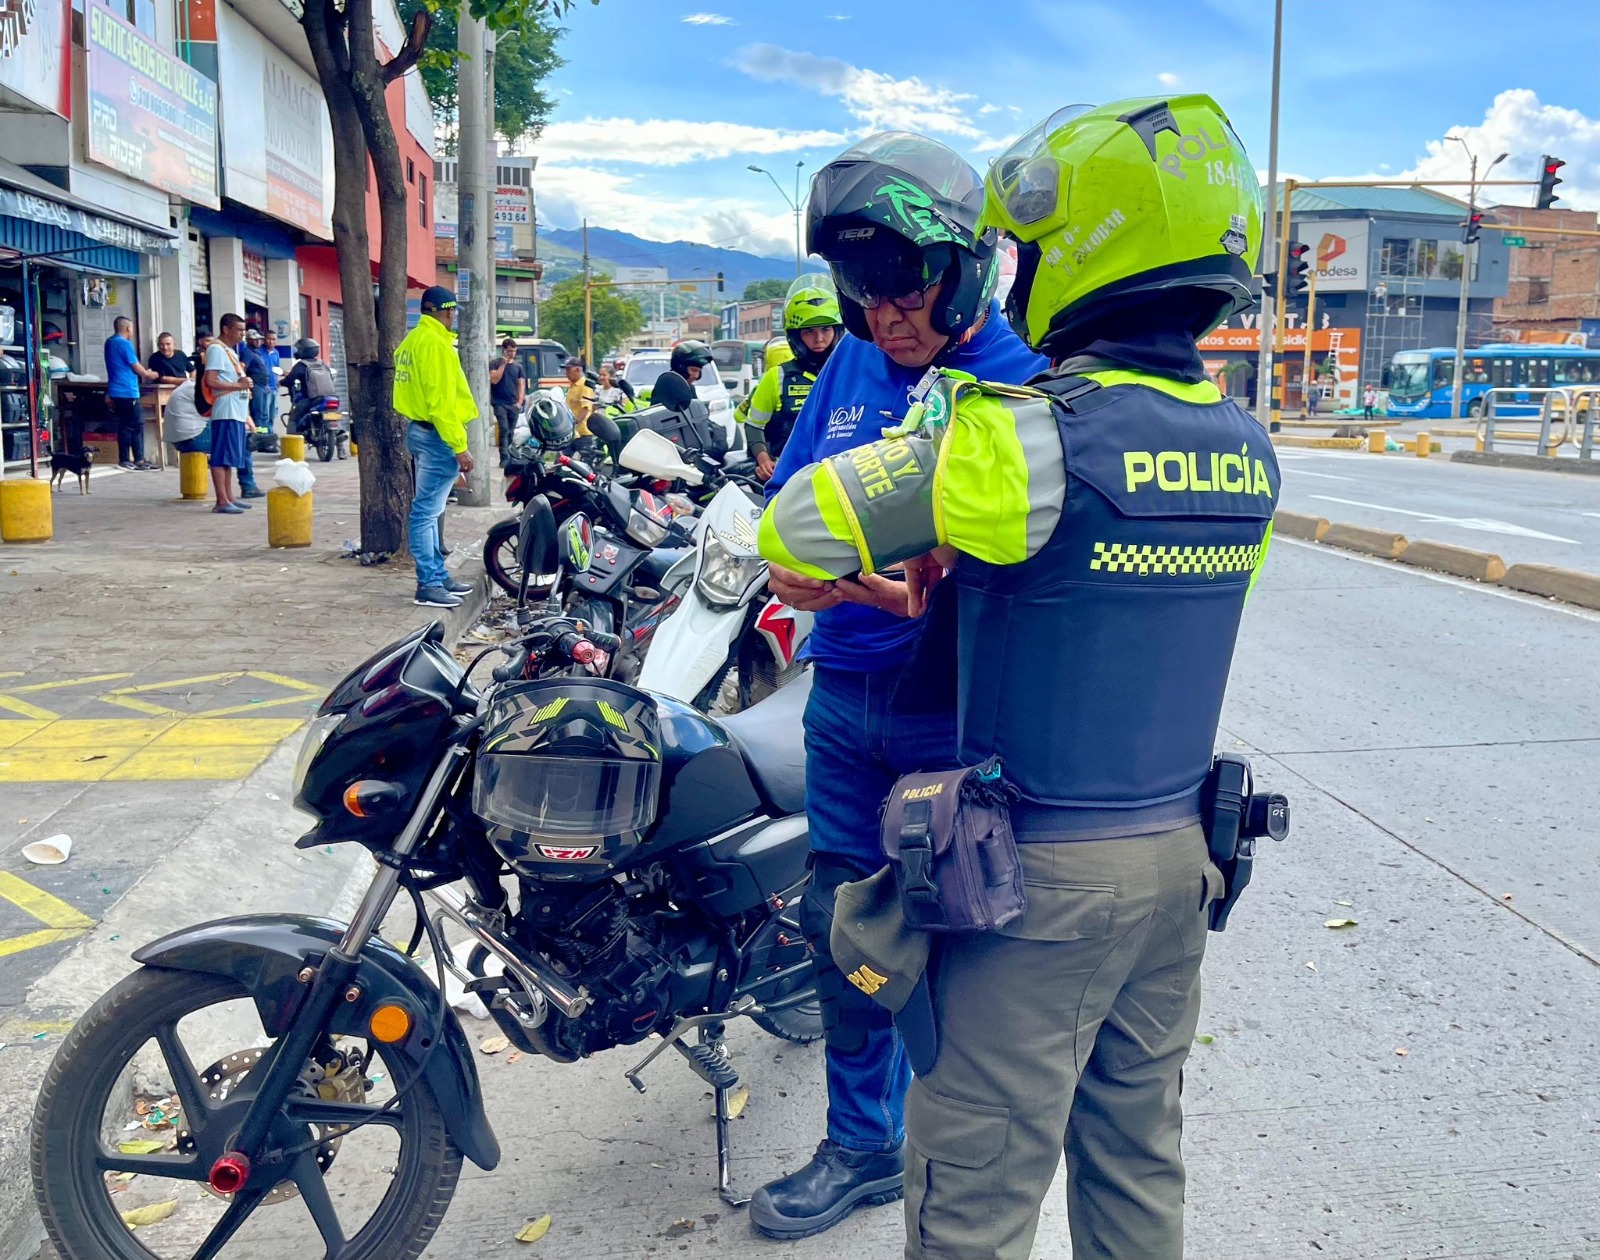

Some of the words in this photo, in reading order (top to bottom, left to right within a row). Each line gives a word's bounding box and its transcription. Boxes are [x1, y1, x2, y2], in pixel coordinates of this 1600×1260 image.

[156, 51, 172, 89] DEL
[93, 99, 117, 132] PRO
[109, 134, 143, 170] RIDER
[837, 227, 876, 240] TEO
[1228, 335, 1252, 346] con
[1123, 441, 1272, 498] POLICÍA
[719, 530, 755, 553] HONDA
[901, 783, 943, 799] POLICIA
